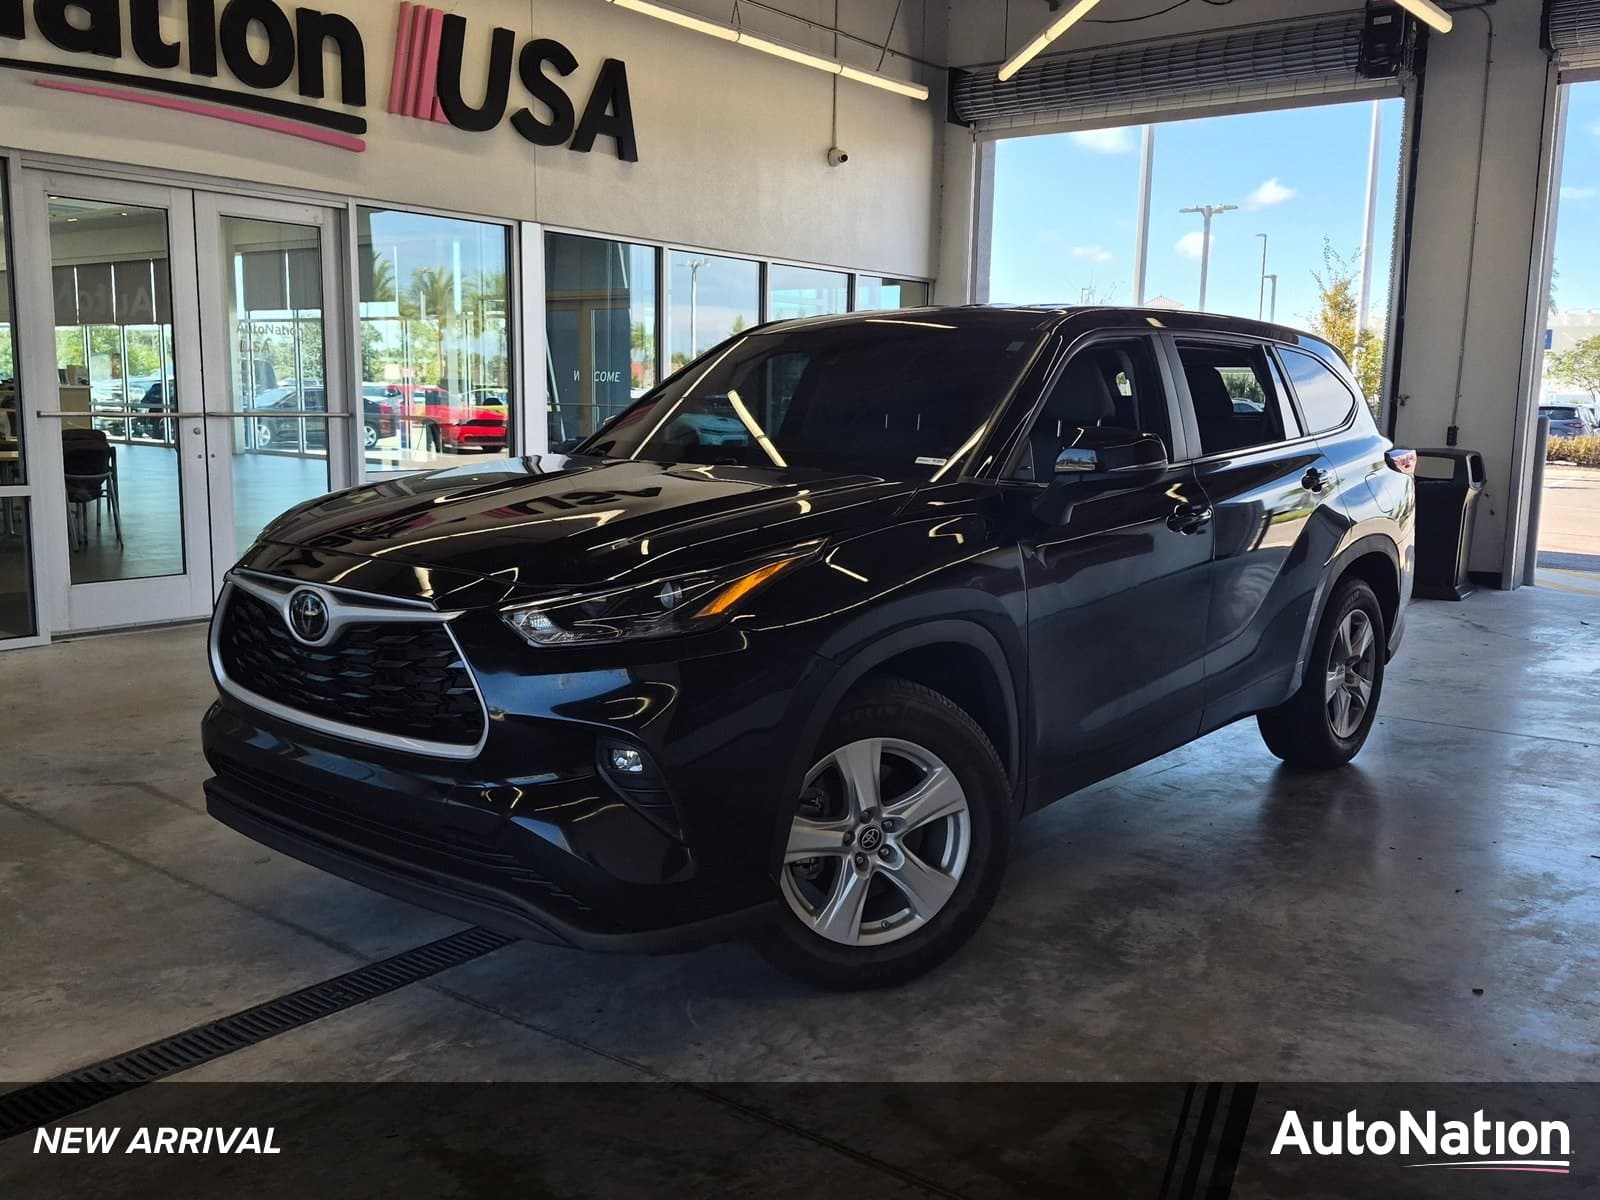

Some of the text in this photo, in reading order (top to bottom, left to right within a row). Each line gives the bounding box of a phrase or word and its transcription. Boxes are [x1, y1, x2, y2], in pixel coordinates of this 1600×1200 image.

[437, 13, 638, 163] USA
[236, 320, 304, 337] AutoNation
[240, 338, 271, 353] USA
[573, 370, 621, 383] WCOME
